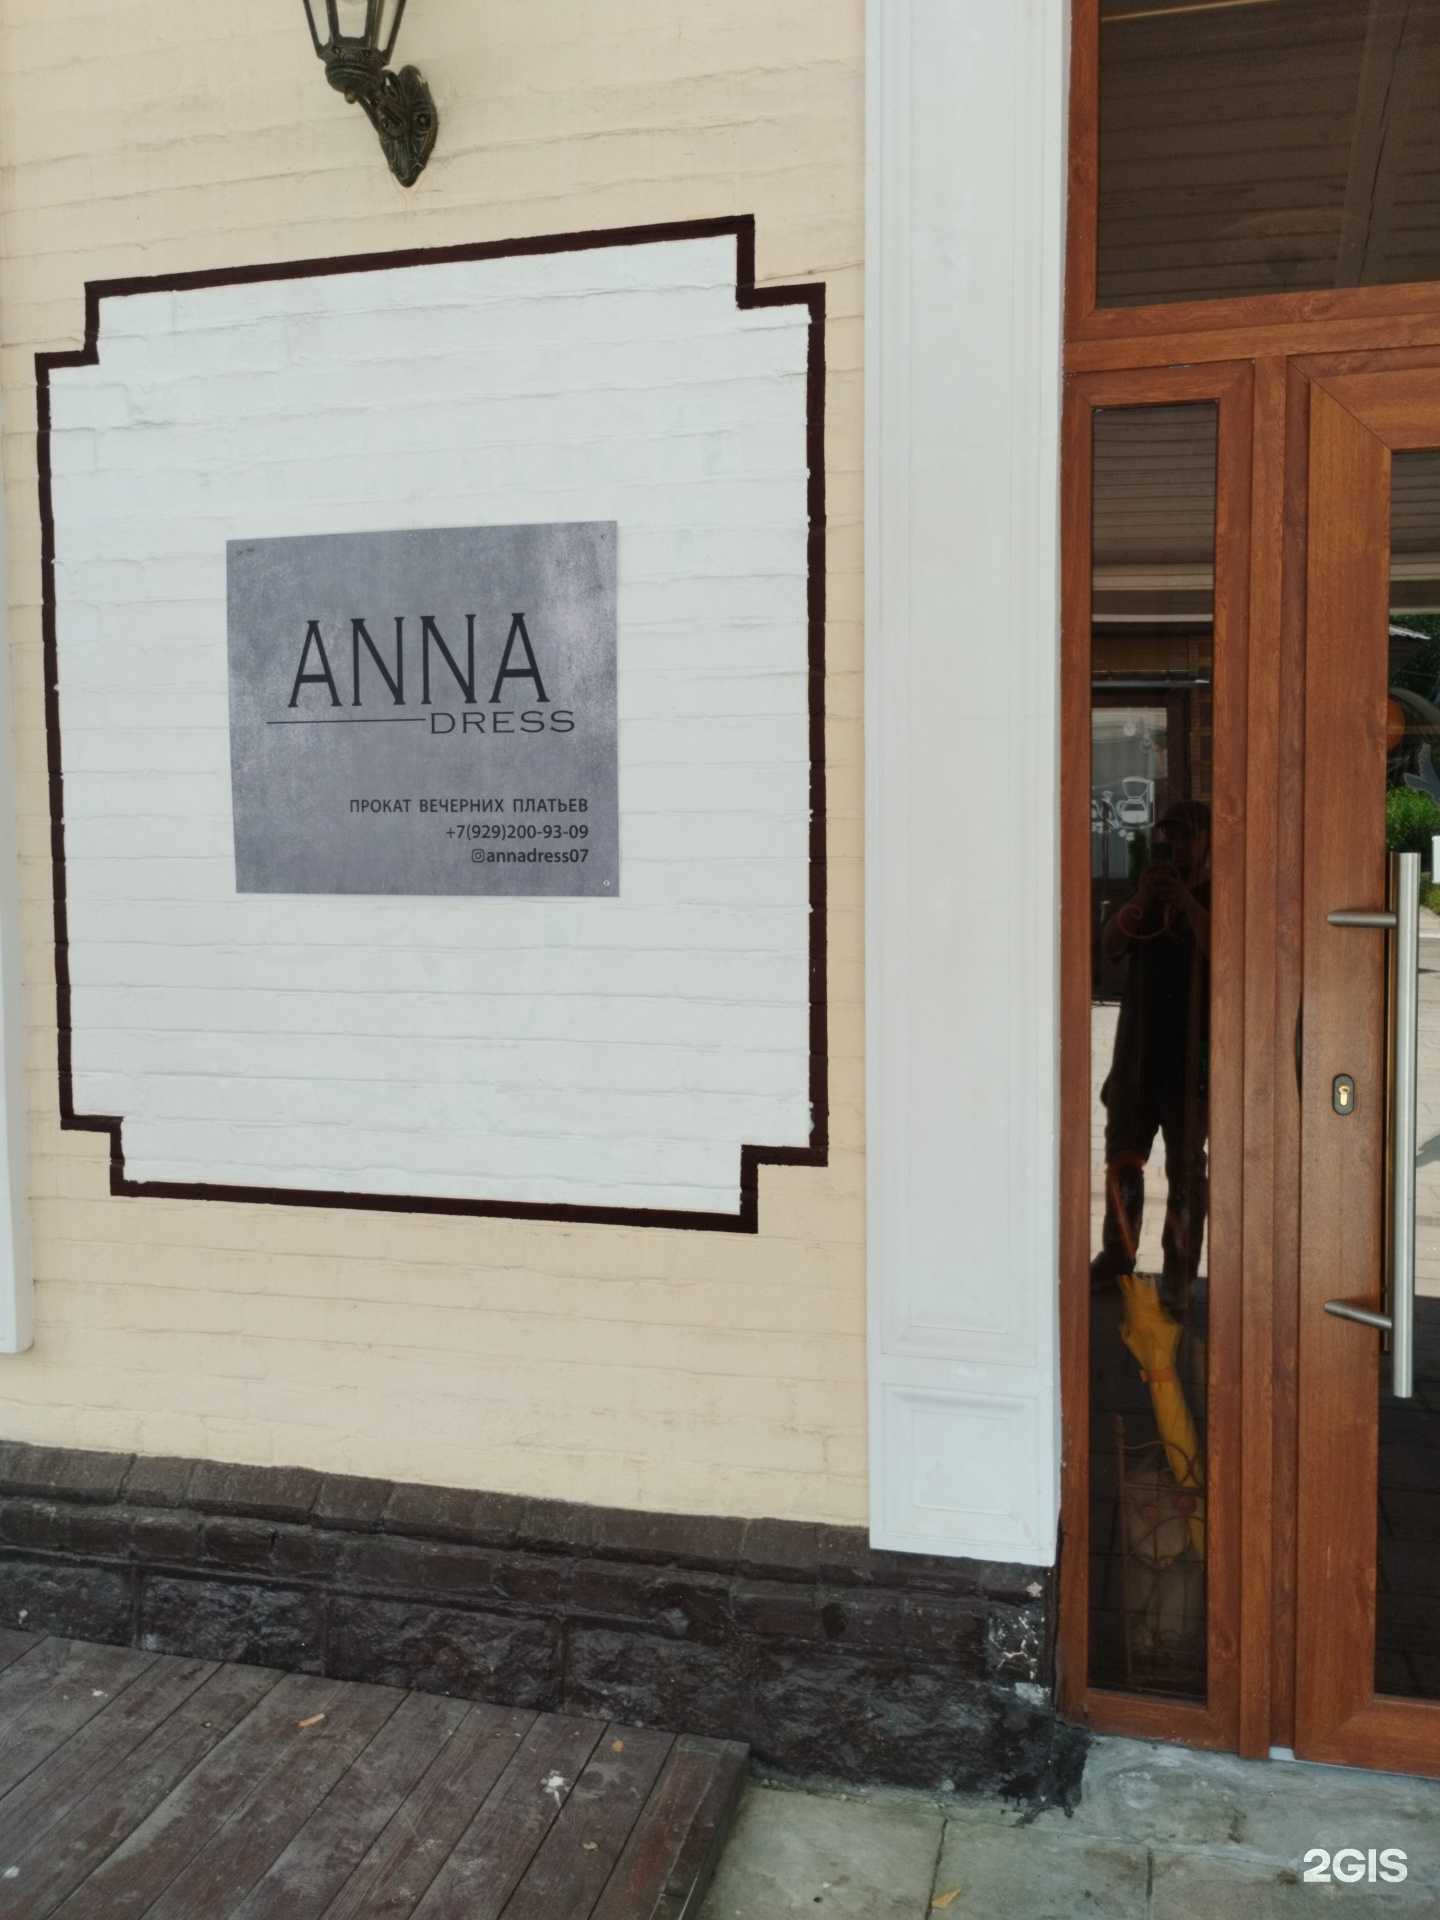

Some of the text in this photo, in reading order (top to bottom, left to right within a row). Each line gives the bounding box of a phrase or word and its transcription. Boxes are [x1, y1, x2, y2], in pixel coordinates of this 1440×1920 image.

[287, 612, 551, 708] ANNA
[430, 710, 576, 734] DRESS
[349, 797, 589, 814] ПРОКАТ ВЕЧЕРНИХ ПЛАТЬЕВ
[445, 823, 589, 841] +7(929)200-93-09
